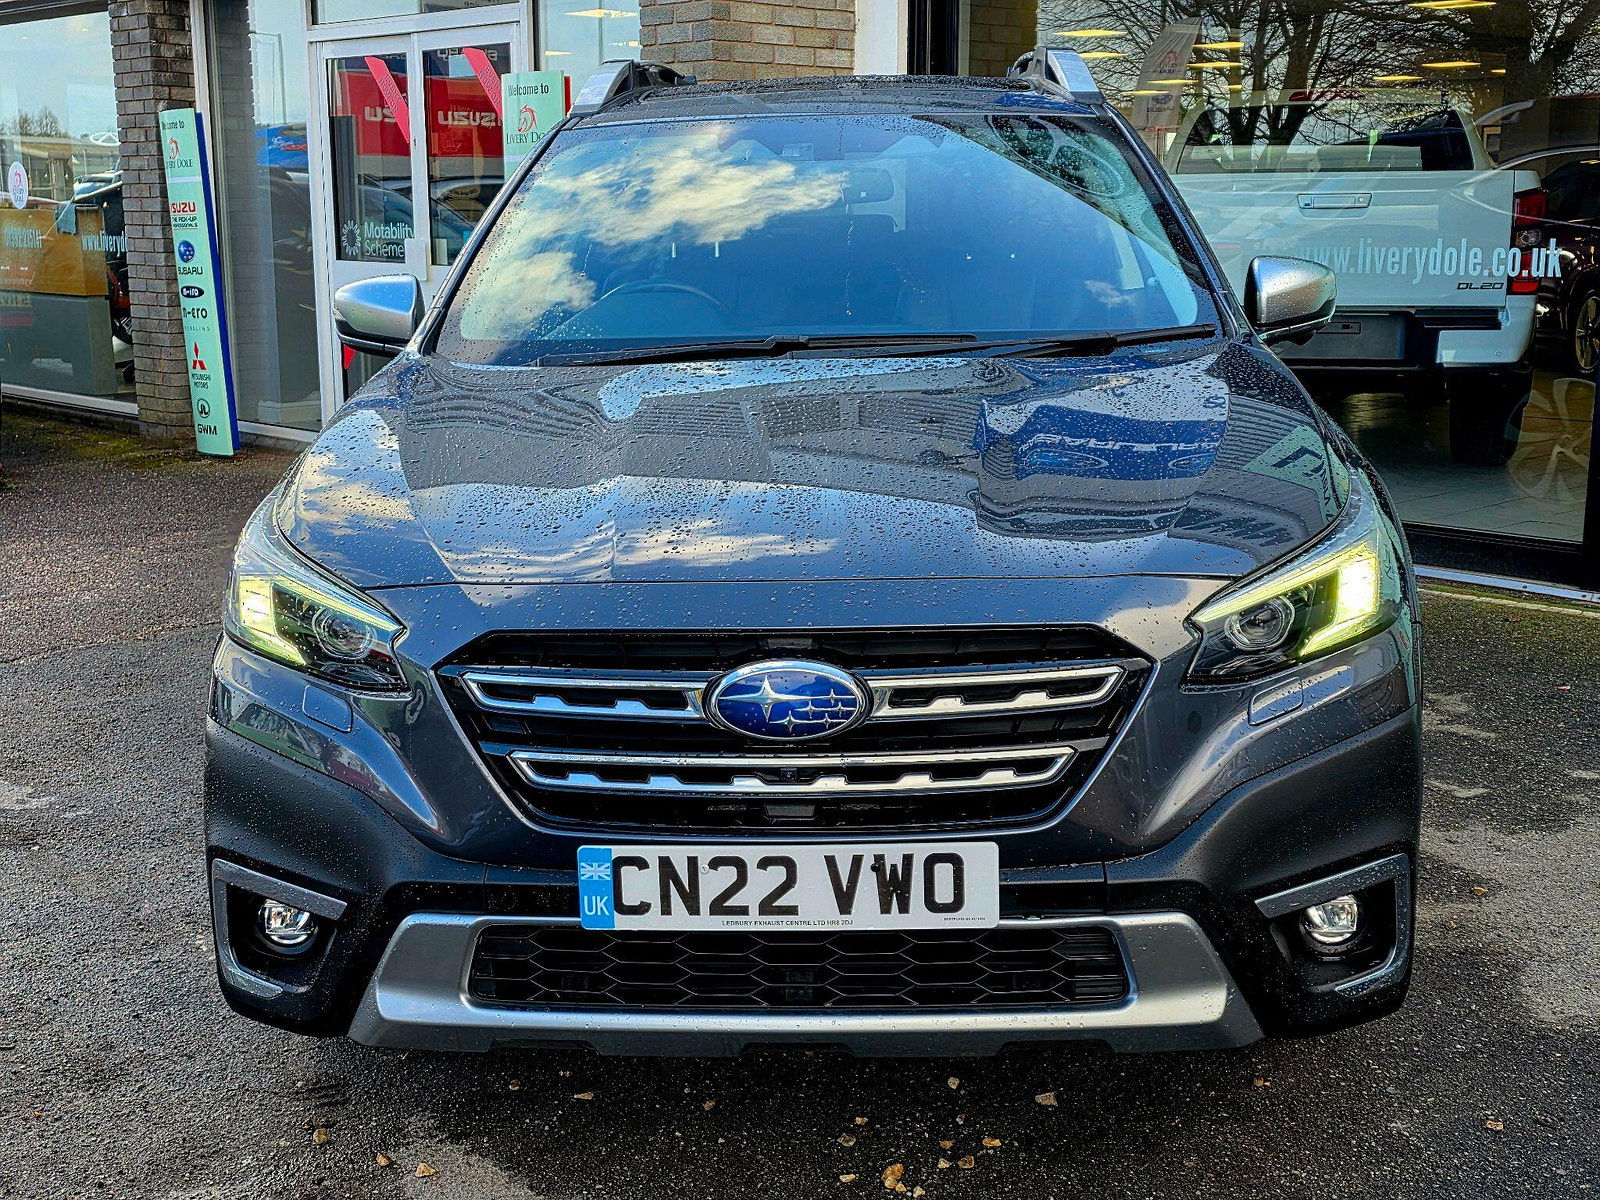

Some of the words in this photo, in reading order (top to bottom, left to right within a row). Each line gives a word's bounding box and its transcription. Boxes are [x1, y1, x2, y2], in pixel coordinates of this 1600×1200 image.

[508, 84, 539, 97] Welcome
[541, 82, 549, 94] to
[531, 131, 546, 143] DO
[171, 201, 196, 213] ISUZU
[365, 239, 405, 257] Scheme
[177, 266, 203, 275] SUBARU
[1456, 282, 1505, 290] DL20
[197, 423, 218, 435] GWM
[612, 855, 799, 916] CN22
[823, 852, 966, 916] VWO
[583, 895, 610, 916] UK
